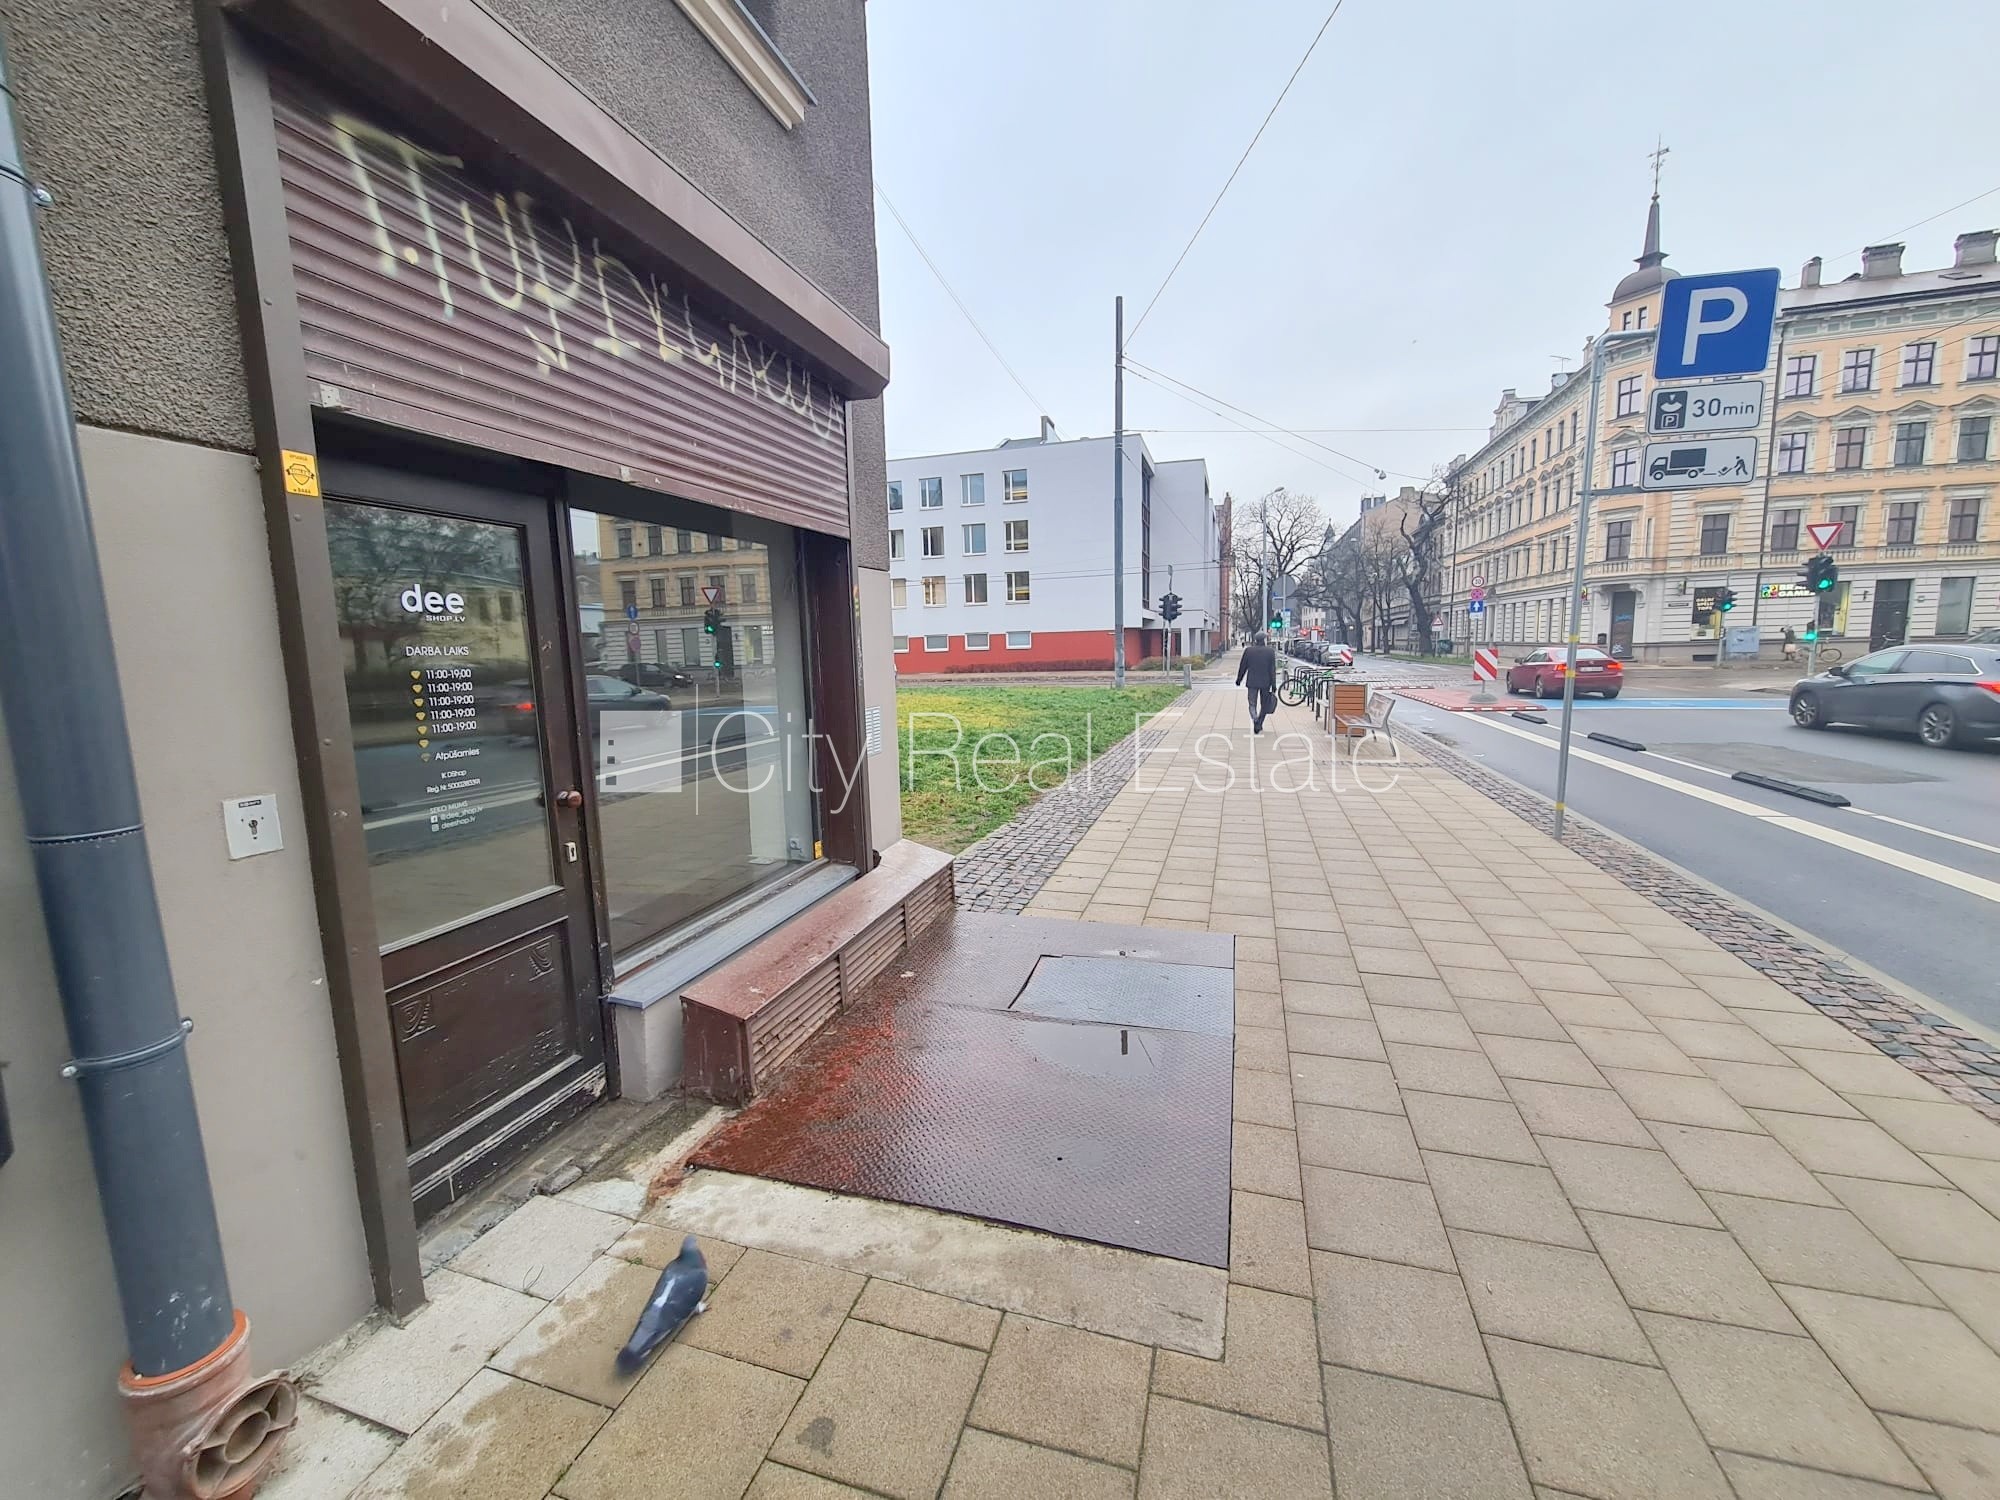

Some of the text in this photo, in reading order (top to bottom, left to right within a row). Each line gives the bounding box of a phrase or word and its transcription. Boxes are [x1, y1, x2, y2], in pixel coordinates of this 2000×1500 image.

[1681, 286, 1749, 366] P
[1664, 415, 1676, 427] P
[401, 583, 465, 614] dee
[405, 645, 470, 657] DARBA LAIKS
[427, 682, 473, 693] 11:00-19:00
[429, 695, 474, 706] 11:00-19:00
[431, 708, 476, 720] 11:00-19:00
[432, 721, 477, 733] 11:00-19:00
